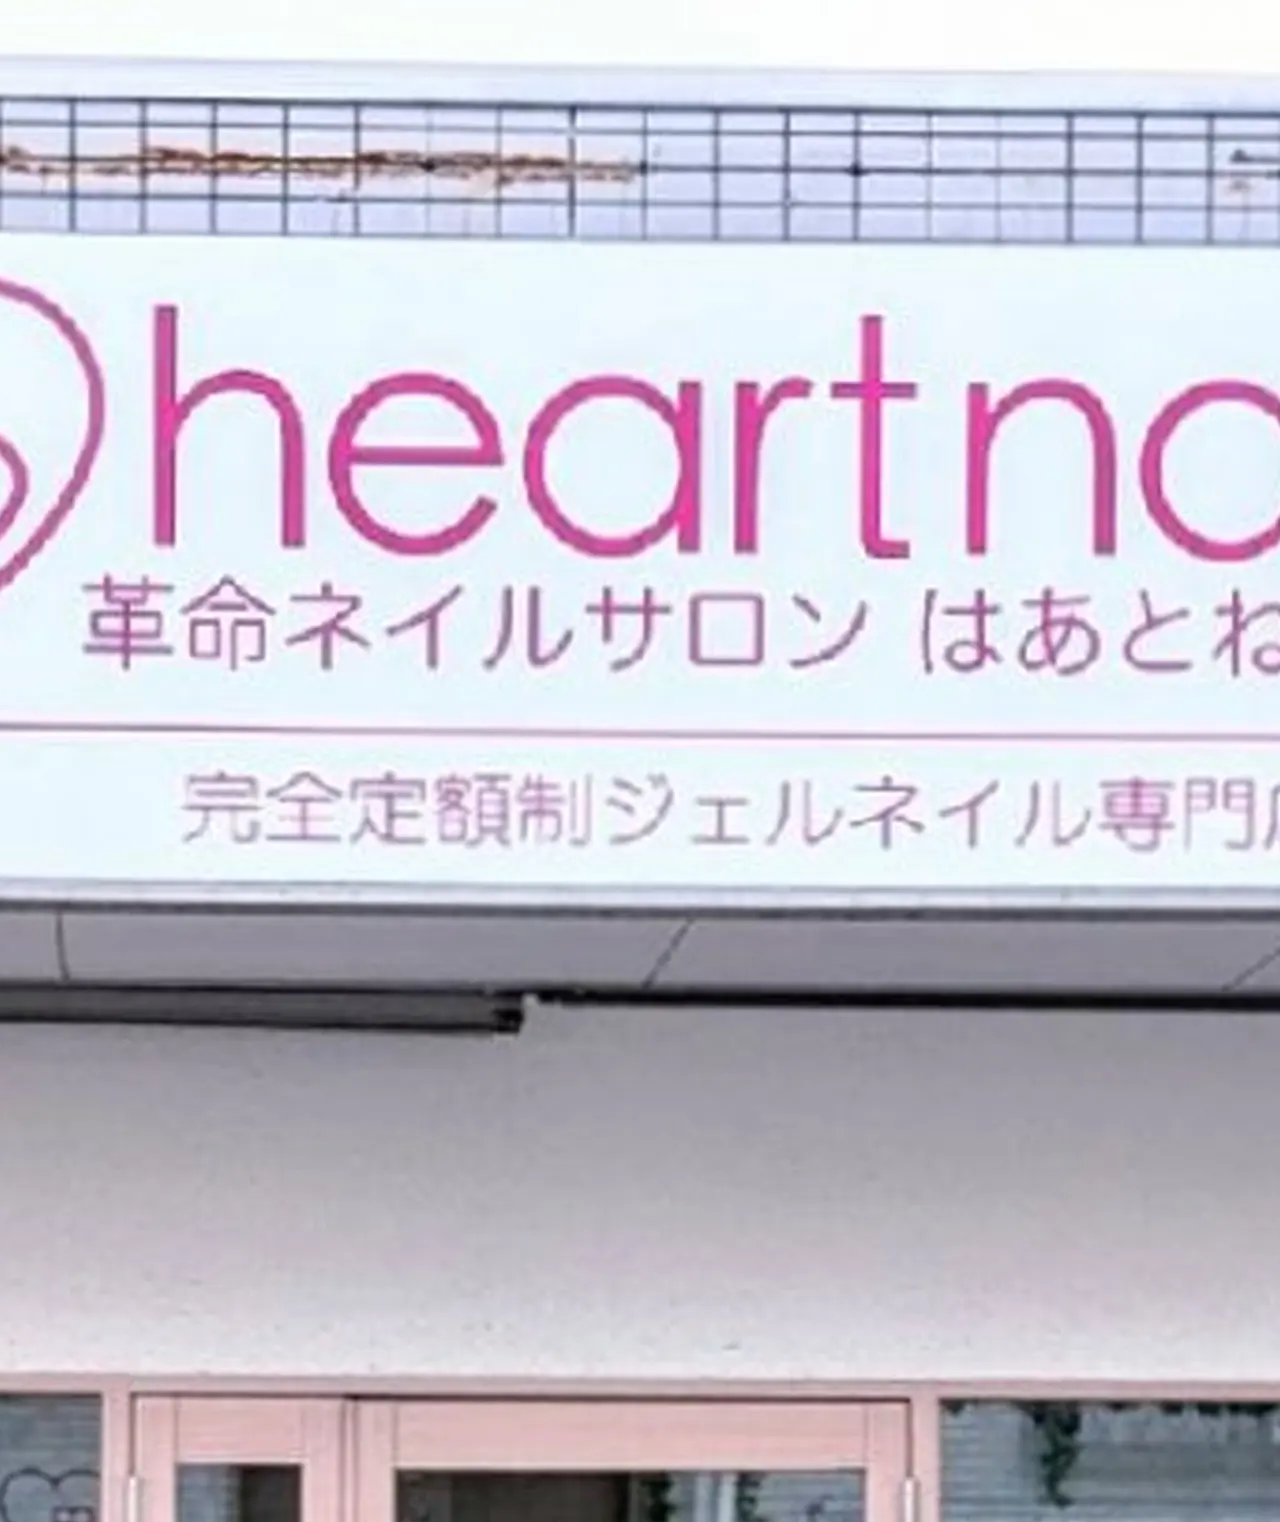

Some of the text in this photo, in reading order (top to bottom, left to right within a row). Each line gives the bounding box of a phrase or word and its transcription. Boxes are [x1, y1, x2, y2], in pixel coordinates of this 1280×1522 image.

[81, 574, 869, 676] 革命ネイルサロン
